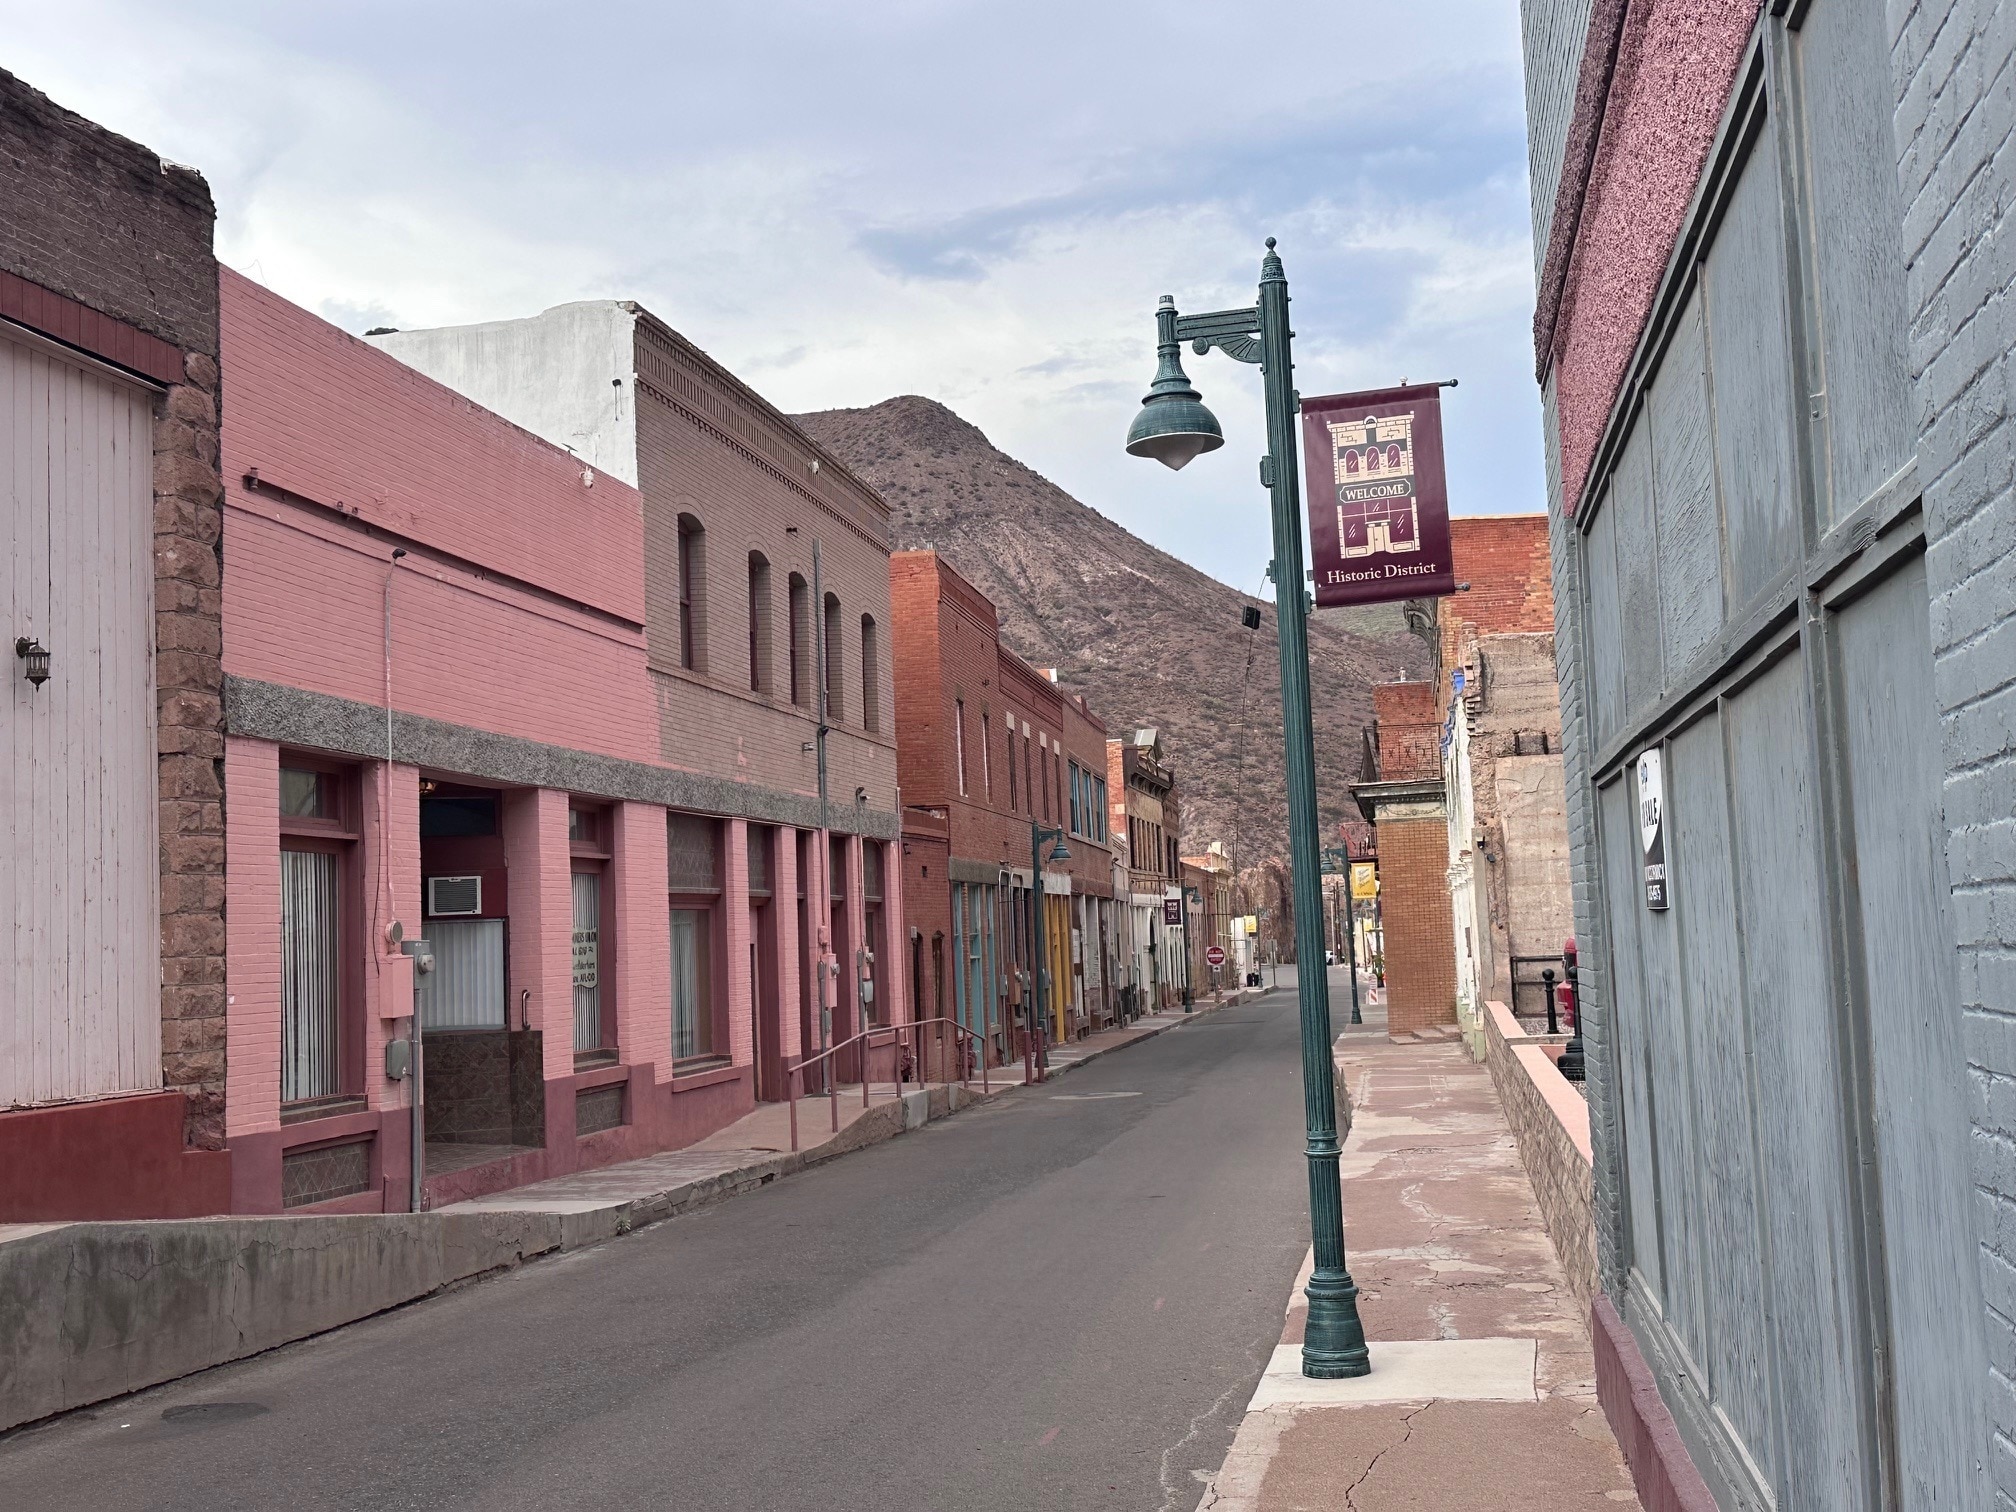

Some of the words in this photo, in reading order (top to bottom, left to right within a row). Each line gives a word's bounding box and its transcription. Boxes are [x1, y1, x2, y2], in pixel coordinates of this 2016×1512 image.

[1346, 484, 1405, 501] WELCOME
[1327, 568, 1382, 584] Historic
[1384, 562, 1436, 578] District
